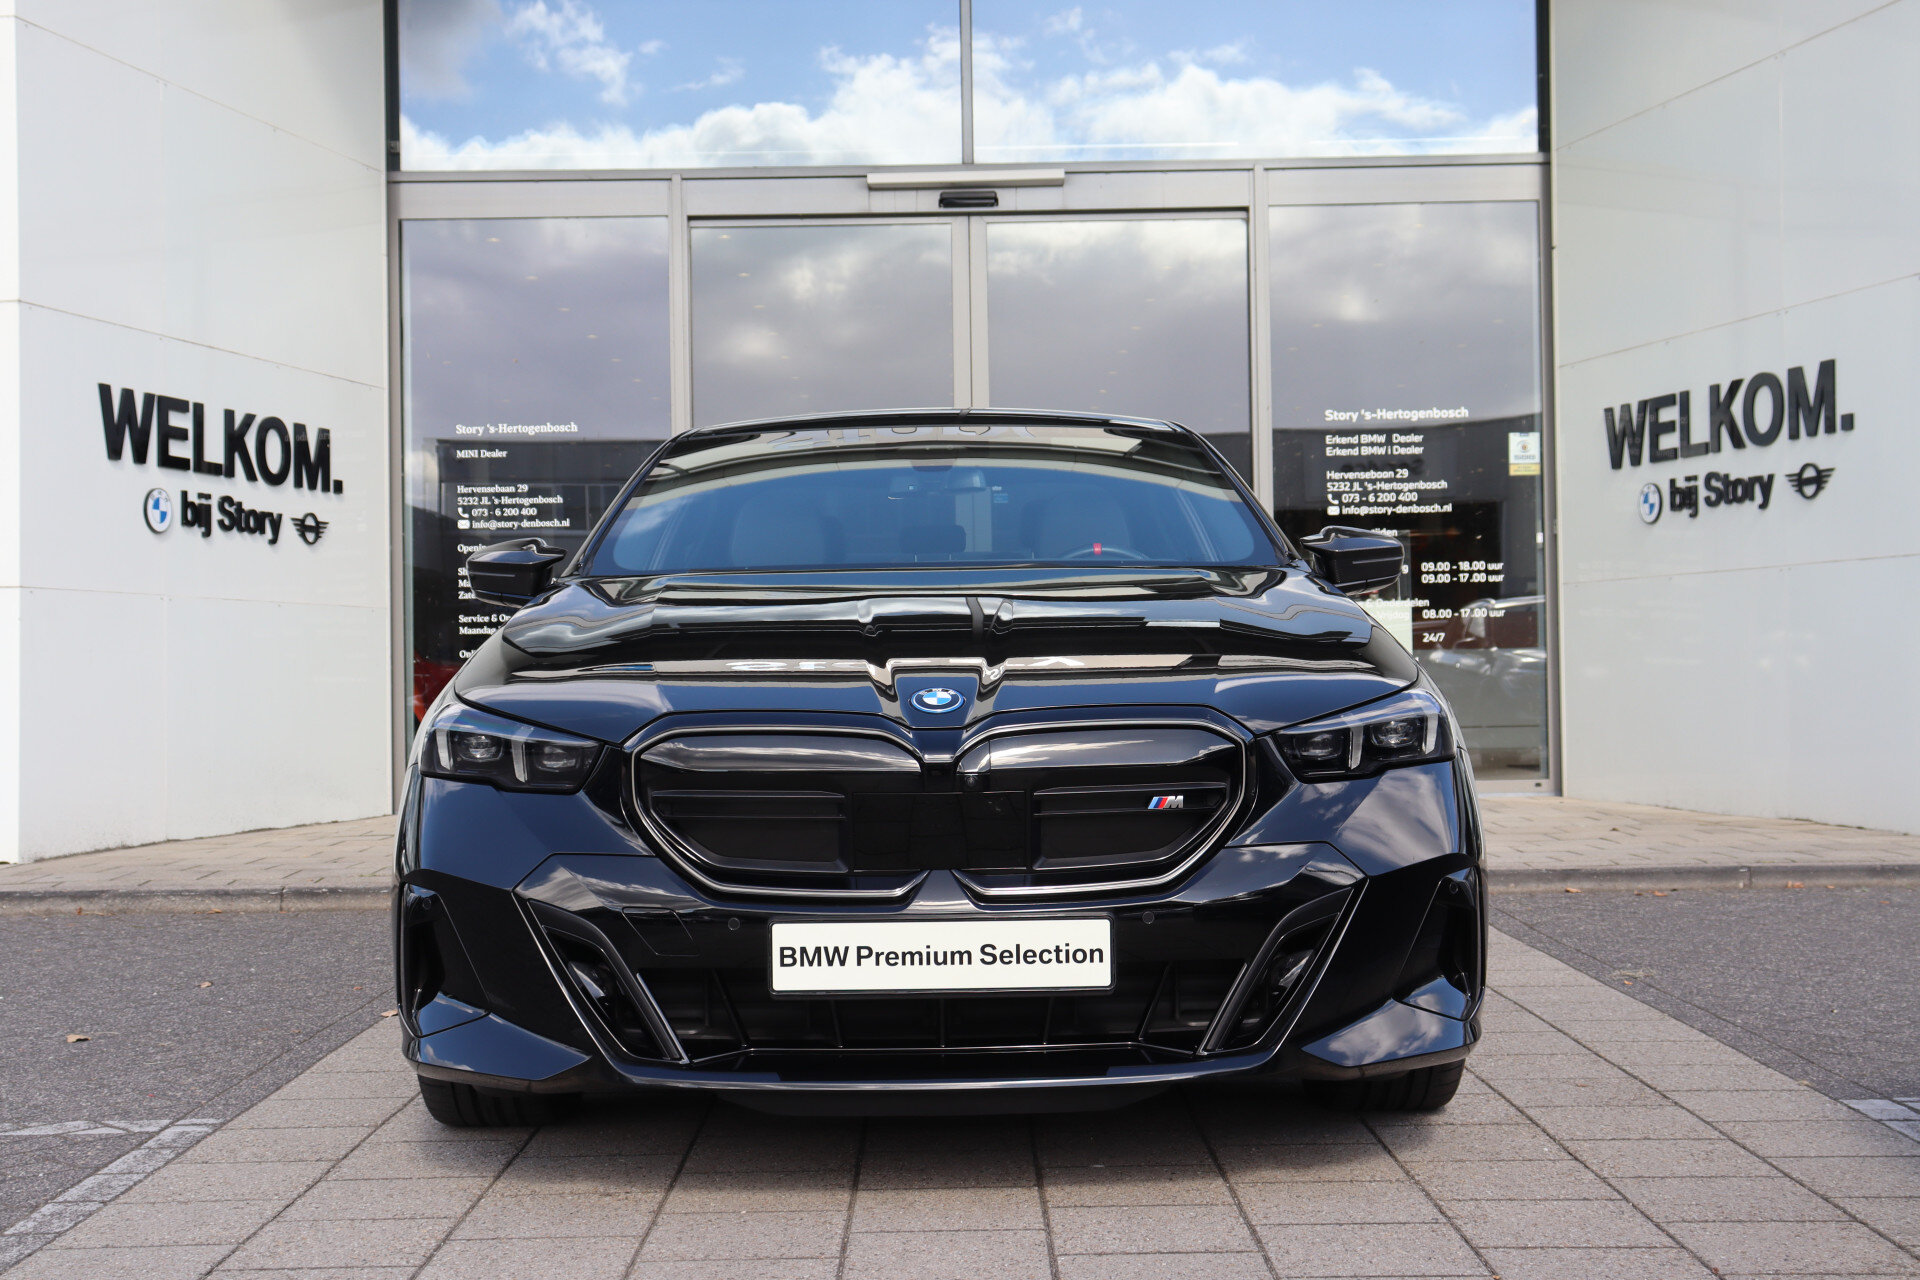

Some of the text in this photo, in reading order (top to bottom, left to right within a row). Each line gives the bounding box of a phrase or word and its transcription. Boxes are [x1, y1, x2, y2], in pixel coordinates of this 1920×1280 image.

[1325, 409, 1358, 422] Story
[1604, 358, 1854, 470] WELKOM.
[456, 424, 484, 436] Story
[97, 382, 343, 494] WELKOM.
[1325, 433, 1424, 445] Erkend BMW Dealer
[456, 448, 508, 459] MINI Dealer
[1326, 446, 1359, 456] Erkend
[1361, 445, 1386, 455] BMW
[1392, 445, 1424, 455] Dealer
[1326, 468, 1409, 480] Hervensebaan 29
[457, 483, 529, 494] Hervensebaan 29
[1326, 482, 1351, 491] 5232
[1352, 481, 1363, 491] JL
[457, 496, 479, 505] 5232
[480, 496, 491, 505] JL
[1341, 493, 1360, 503] 073
[1368, 493, 1375, 502] 6
[1377, 492, 1396, 502] 200
[1398, 491, 1418, 502] 400
[1669, 471, 1775, 519] bij Story
[471, 507, 489, 517] 073
[494, 507, 502, 517] 6
[502, 507, 519, 516] 200
[520, 507, 537, 516] 400
[1342, 502, 1453, 516] info@story-denbosch.nl
[180, 490, 283, 545] bij Story
[472, 518, 570, 530] info@story-denbosch.nl
[1421, 561, 1451, 572] 09.00
[1458, 560, 1486, 571] 18.00
[1487, 562, 1504, 571] uur
[1421, 573, 1451, 584] 09.00
[1488, 574, 1504, 583] uur
[458, 614, 490, 623] Service
[1422, 608, 1452, 619] 08.00
[1488, 609, 1506, 618] uur
[1422, 632, 1446, 643] 24/7
[778, 943, 1104, 967] BMW Premium Selection
